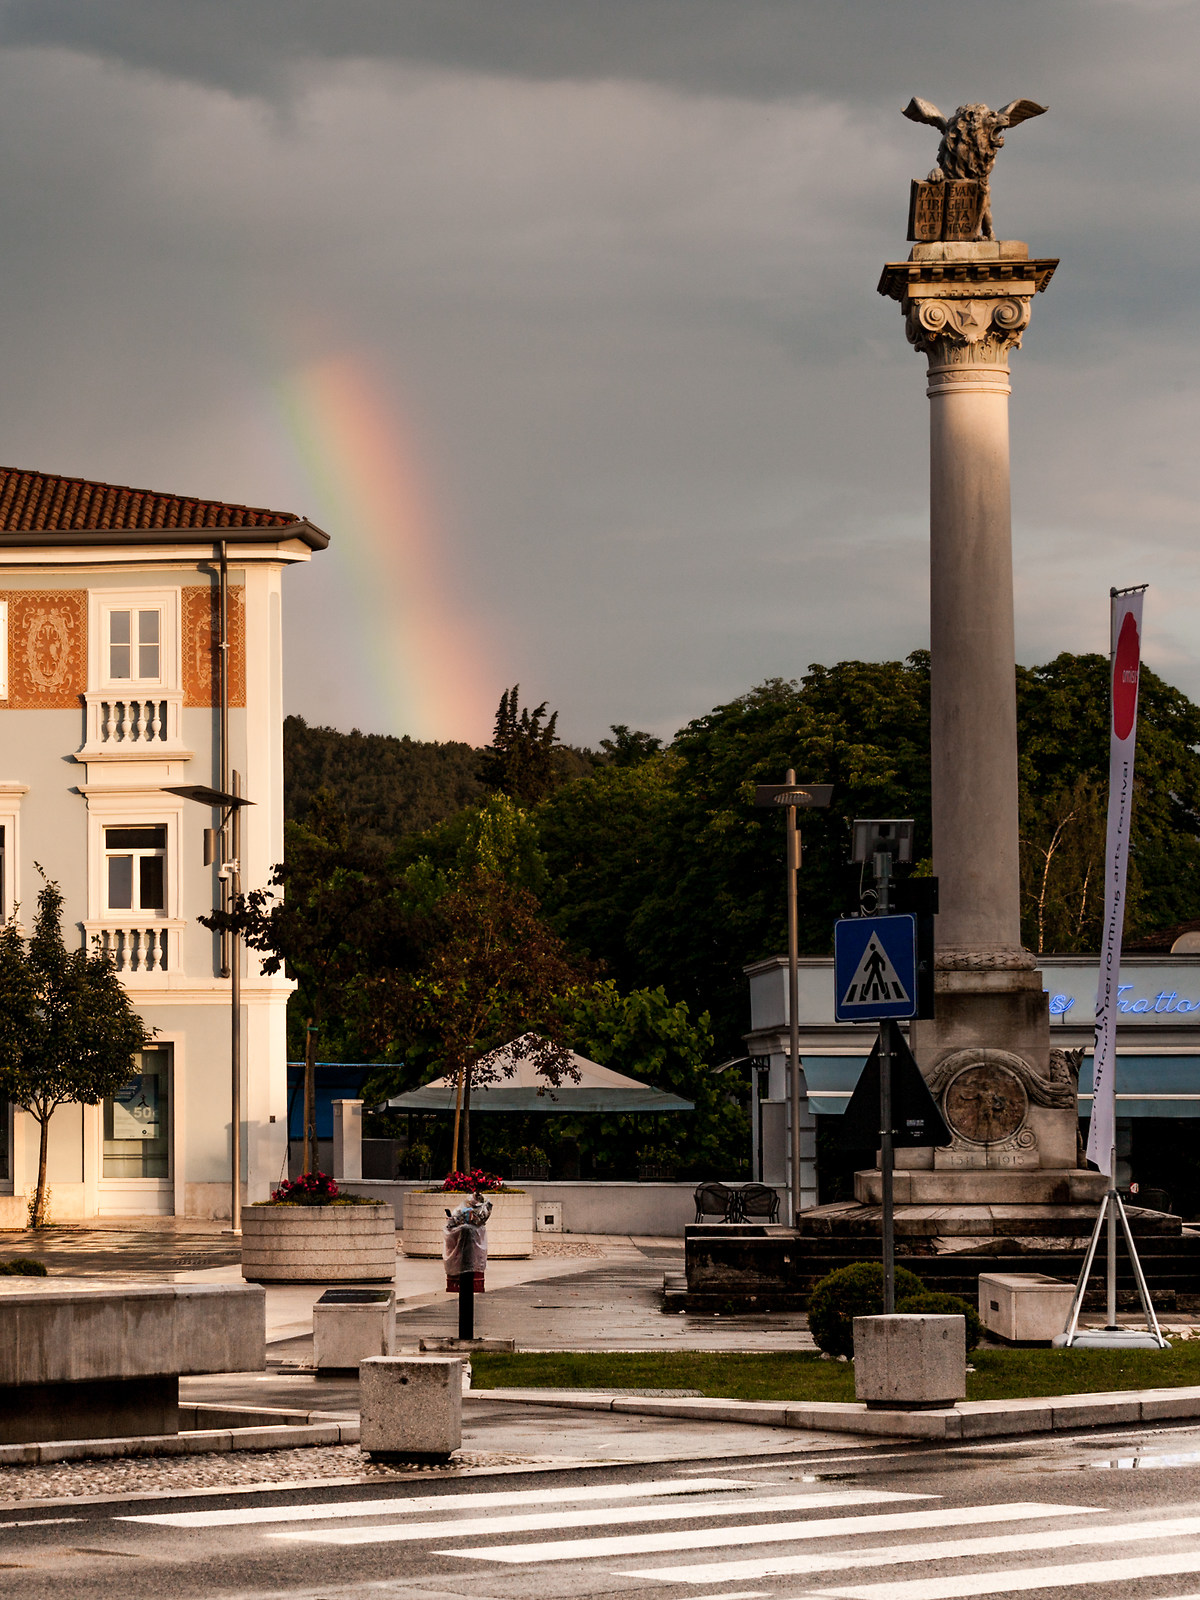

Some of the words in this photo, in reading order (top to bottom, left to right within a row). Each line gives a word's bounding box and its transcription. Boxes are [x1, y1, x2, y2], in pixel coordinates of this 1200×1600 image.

[919, 186, 944, 198] PAX
[1117, 761, 1128, 834] festival
[1114, 842, 1122, 883] arts
[1115, 984, 1200, 1014] Tratto
